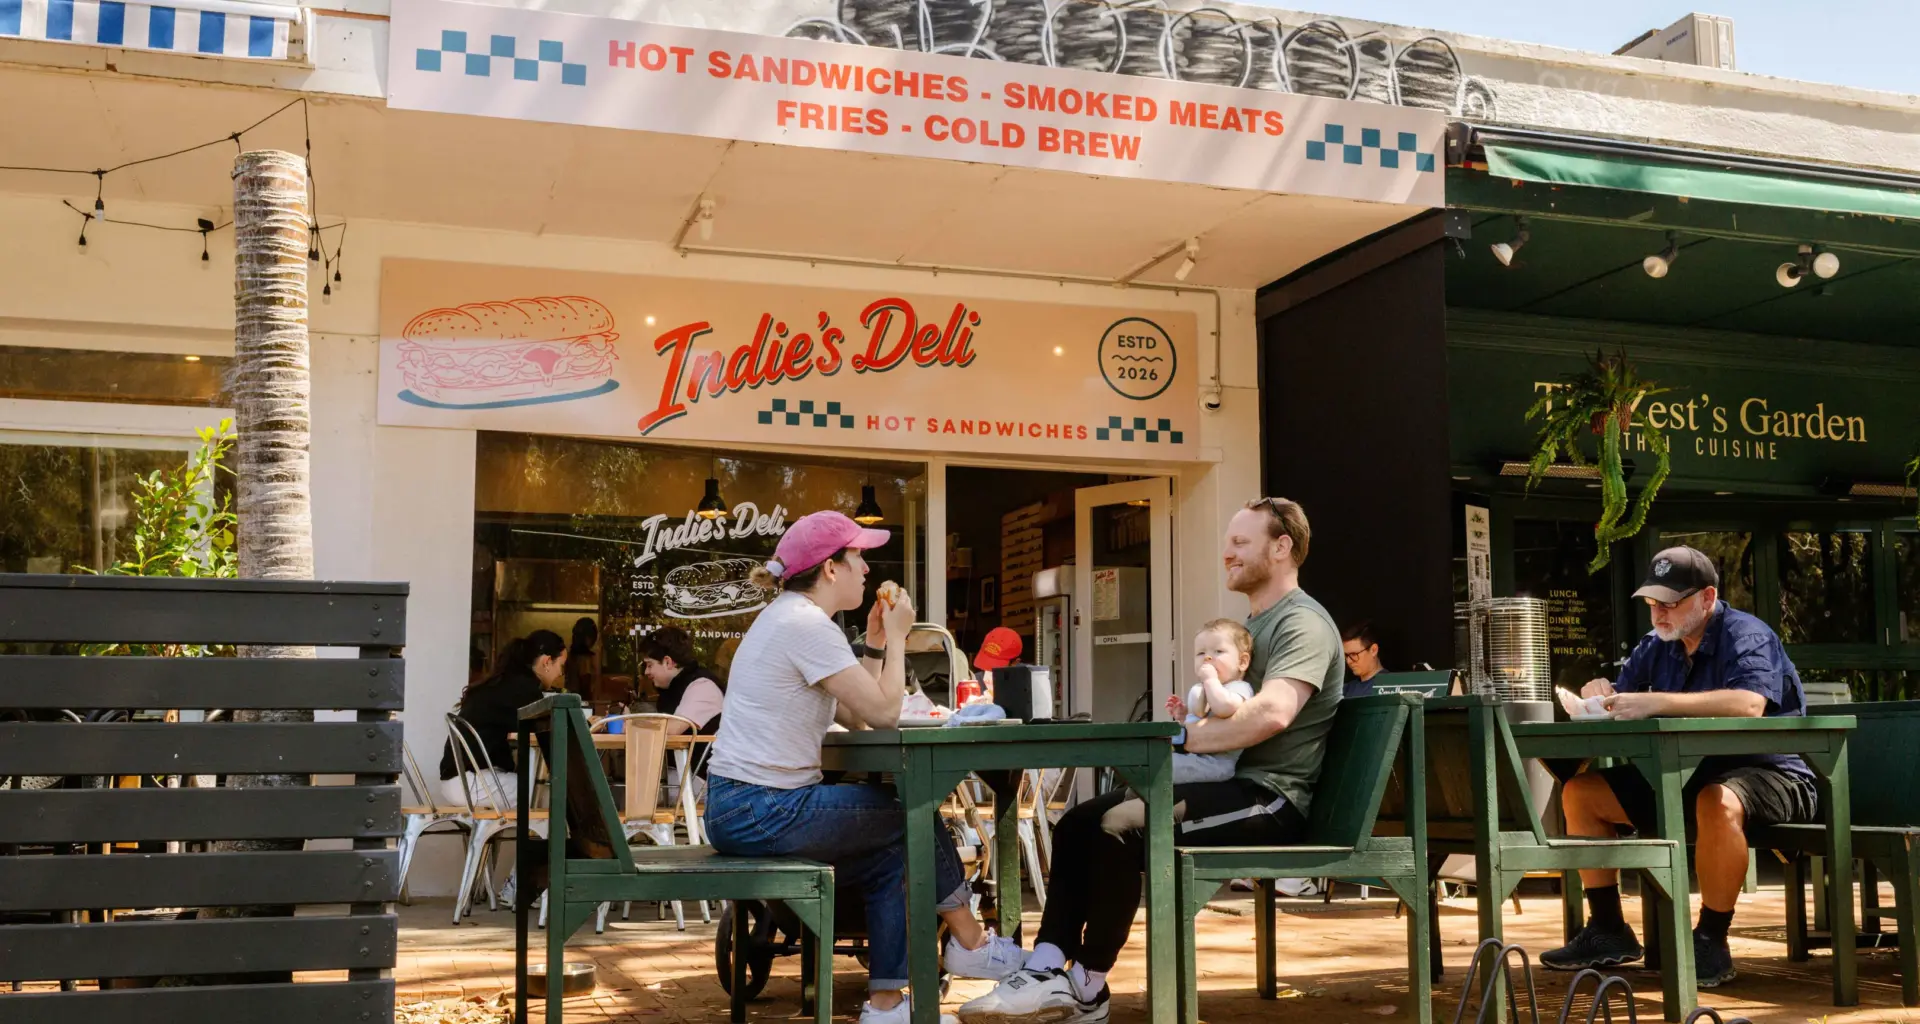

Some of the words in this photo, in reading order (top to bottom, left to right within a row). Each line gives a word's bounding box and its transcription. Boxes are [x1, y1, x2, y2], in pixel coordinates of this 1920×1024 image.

[608, 39, 695, 75] HOT
[706, 49, 969, 103] SANDWICHES
[1003, 81, 1159, 123] SMOKED
[1168, 99, 1285, 137] MEATS
[776, 99, 889, 137] FRIES
[923, 113, 1027, 149] COLD
[1037, 125, 1142, 161] BREW
[1117, 335, 1157, 349] ESTD
[637, 310, 846, 434] Indie's
[849, 296, 983, 374] Deli
[1117, 366, 1158, 381] 2026
[865, 414, 918, 433] HOT
[926, 416, 1090, 441] SANDWICHES
[1740, 397, 1868, 443] Garden
[1623, 432, 1671, 453] THI
[1695, 438, 1777, 461] CUISINE
[634, 508, 728, 569] Indie's
[728, 501, 788, 540] Deli
[632, 581, 655, 590] ESTD
[1549, 589, 1578, 598] LUNCH
[1549, 616, 1580, 625] DINNER
[694, 630, 747, 639] SANDWICH
[1102, 636, 1118, 644] OPEN
[1553, 647, 1575, 655] WINE
[1576, 647, 1597, 655] ONLY
